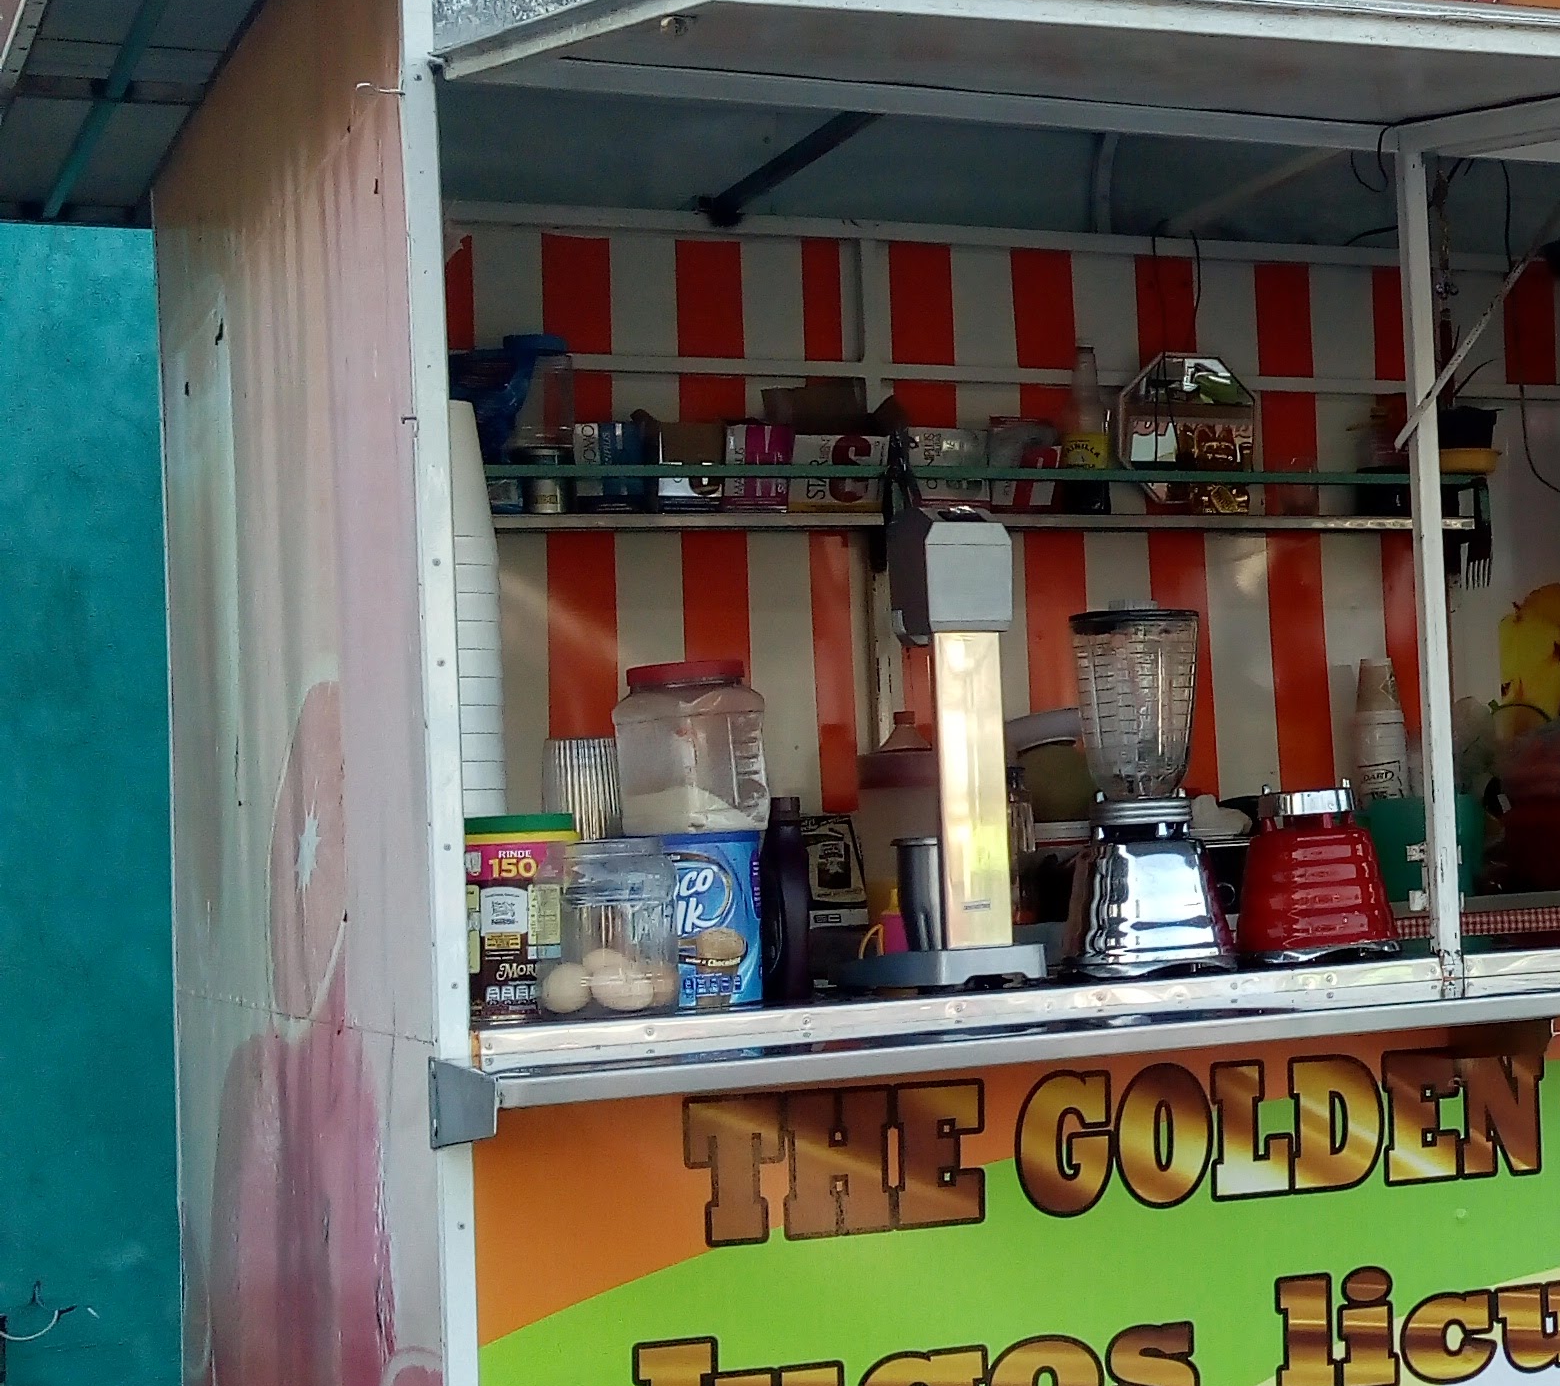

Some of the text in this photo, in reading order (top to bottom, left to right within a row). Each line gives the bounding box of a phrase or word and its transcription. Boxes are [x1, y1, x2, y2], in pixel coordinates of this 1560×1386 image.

[498, 850, 532, 858] RINDE
[488, 858, 537, 878] 150
[682, 1077, 987, 1245] THE
[1014, 1052, 1544, 1216] GOLDEN
